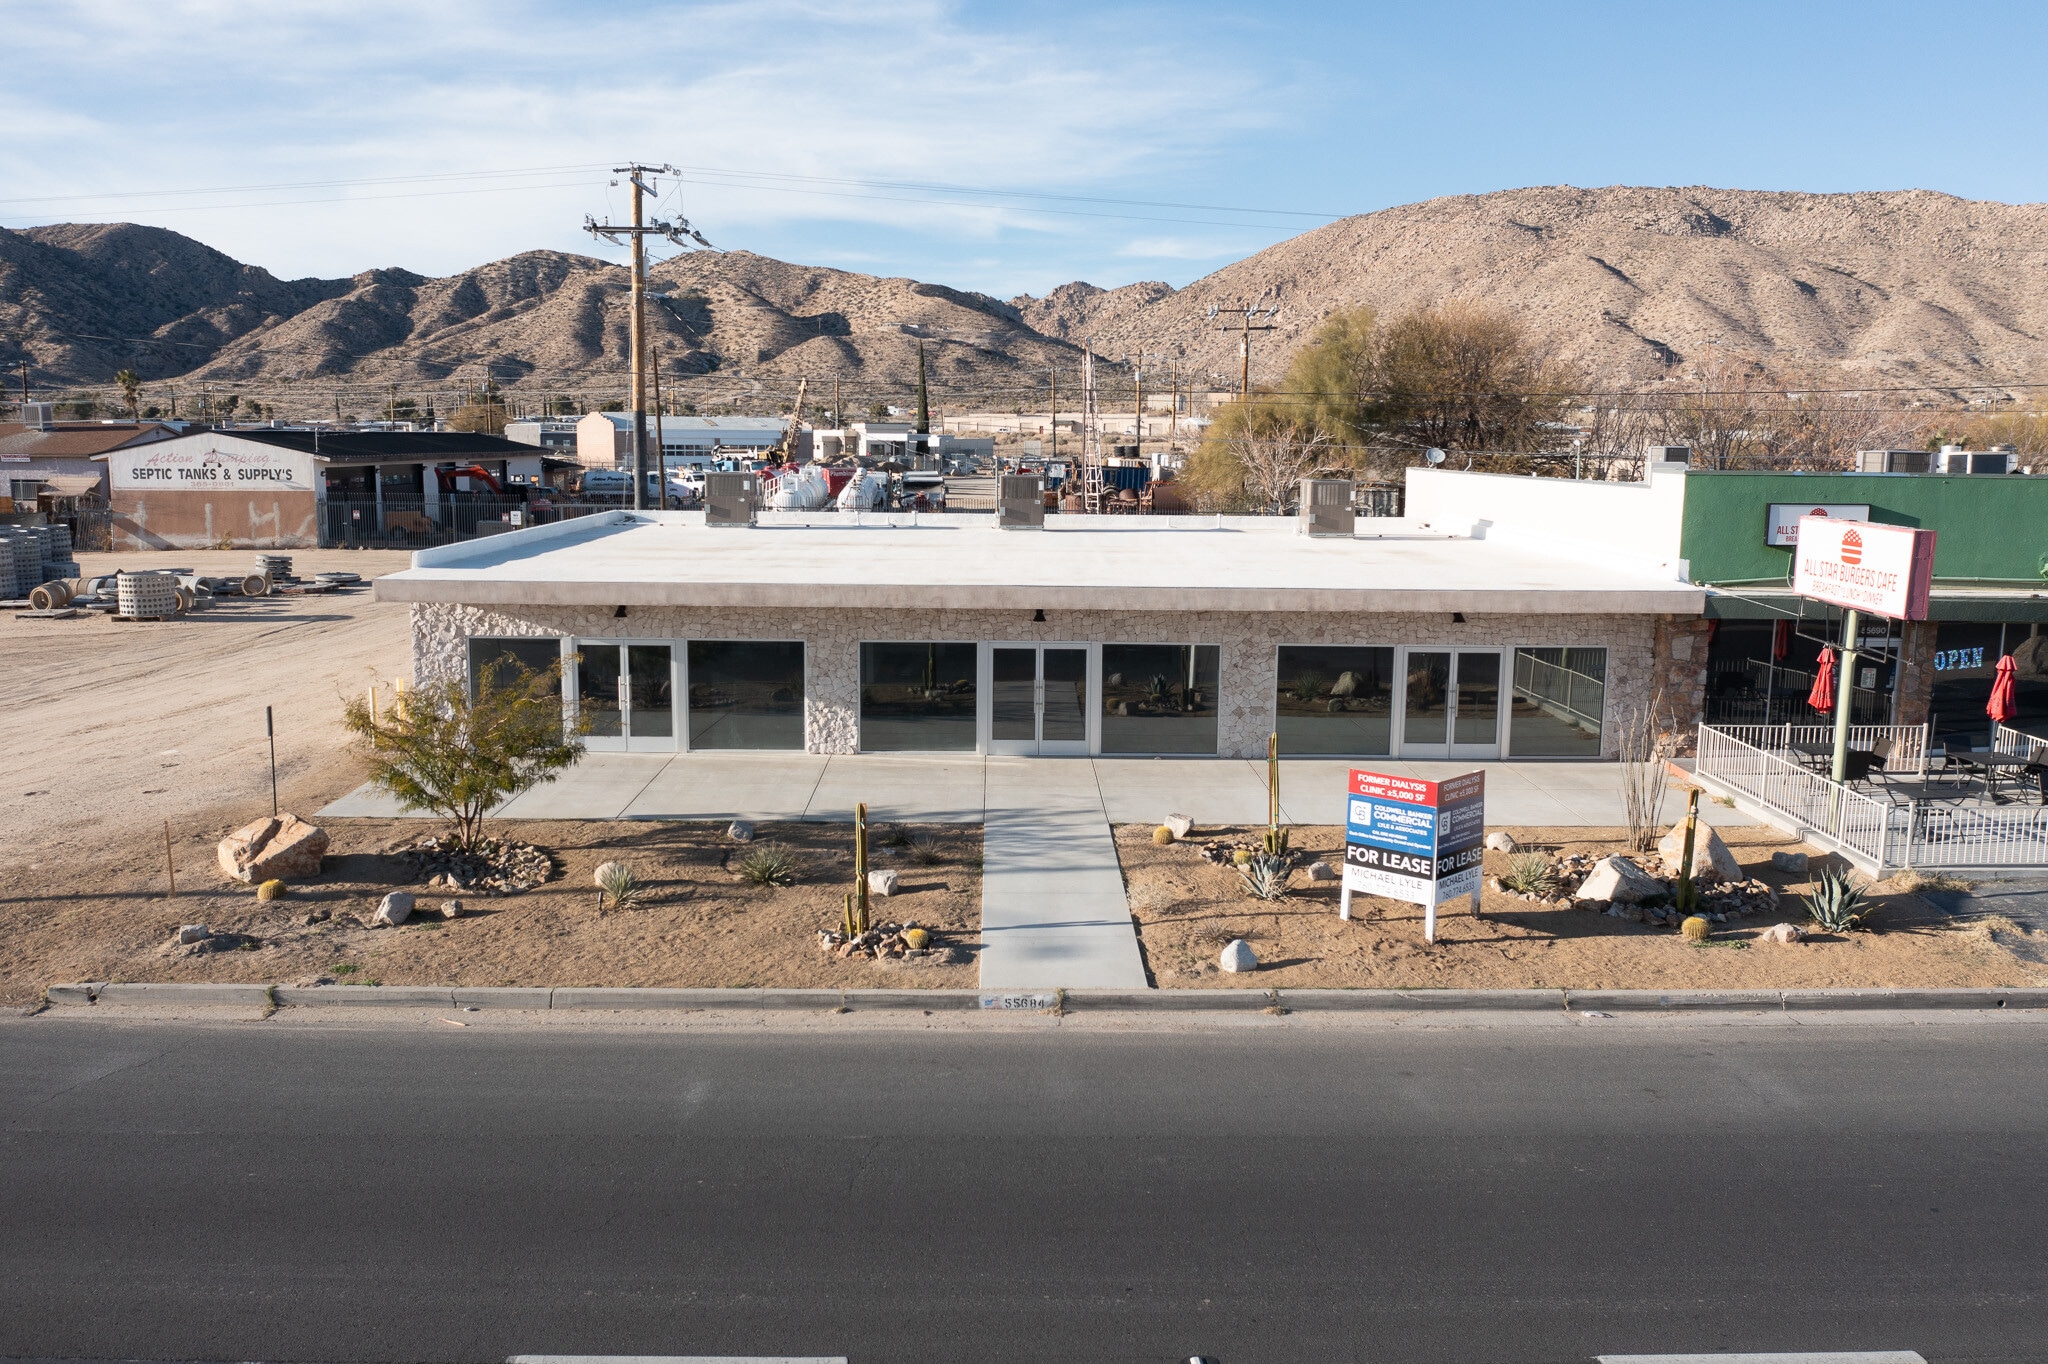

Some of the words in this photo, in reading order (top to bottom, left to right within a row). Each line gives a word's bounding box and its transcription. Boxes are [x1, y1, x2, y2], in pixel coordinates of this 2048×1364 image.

[132, 468, 172, 480] SEPTIC
[178, 468, 217, 480] TANKS
[223, 468, 232, 480] &
[1777, 525, 1789, 535] ALL
[1791, 525, 1799, 535] ST
[1804, 558, 1817, 577] ALL
[1819, 561, 1838, 580] STAR
[1839, 564, 1876, 588] BURGERS
[1876, 571, 1898, 592] CAFE
[1934, 646, 1984, 671] OPEN
[1357, 774, 1391, 787] FORMER
[1391, 780, 1427, 792] DIALYSIS
[1360, 784, 1386, 796] CLINIC
[1414, 793, 1426, 801] SF
[1373, 804, 1407, 815] COLDWELL
[1451, 808, 1483, 824] COMMERCIAL
[1373, 811, 1433, 829] COMMERCIAL
[1347, 845, 1379, 865] FOR
[1382, 852, 1431, 876] LEASE
[1437, 856, 1455, 874] FOR
[1456, 847, 1482, 868] LEASE
[1351, 867, 1396, 885] MICHAEL
[1399, 877, 1423, 890] LYLE
[1439, 873, 1465, 890] MICHAEL
[1465, 868, 1479, 881] LYLE
[1004, 998, 1045, 1008] 55684
